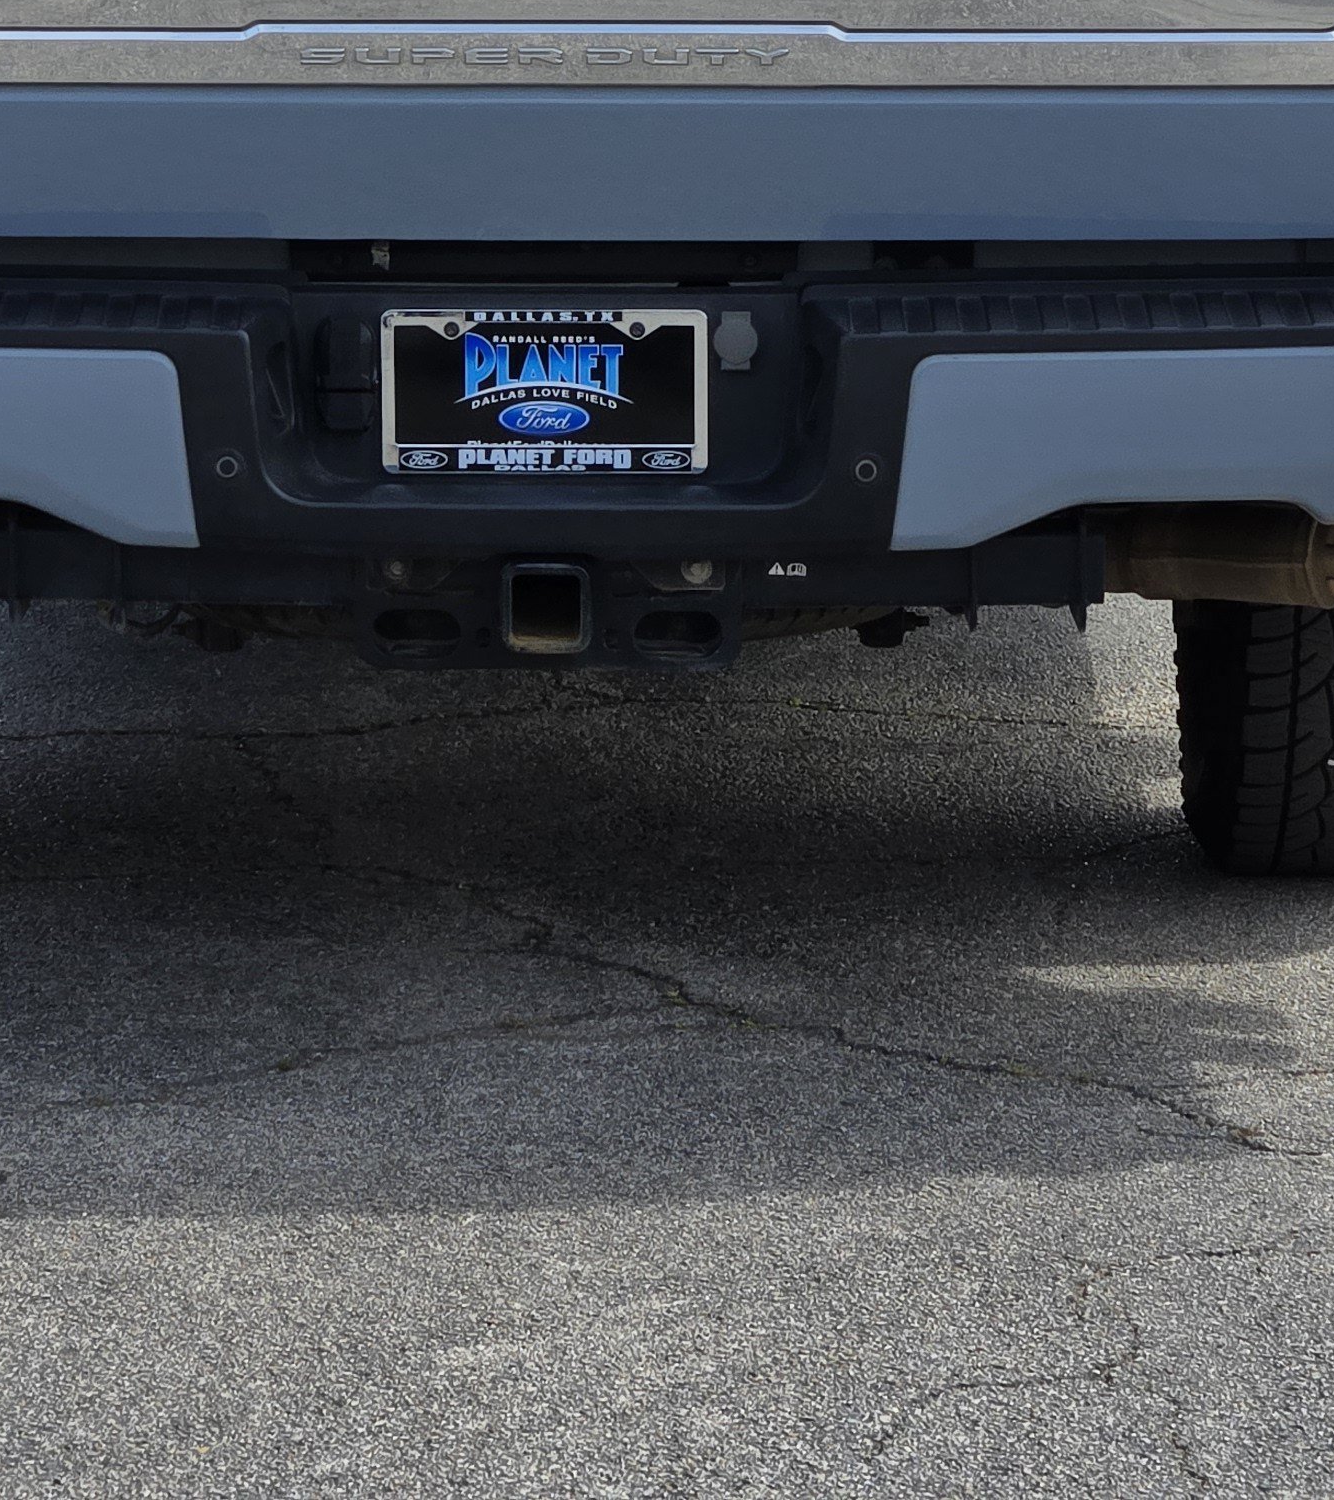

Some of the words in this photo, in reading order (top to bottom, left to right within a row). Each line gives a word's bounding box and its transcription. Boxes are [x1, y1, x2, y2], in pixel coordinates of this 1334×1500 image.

[300, 46, 564, 66] SUPER
[586, 46, 790, 66] DUTY
[584, 311, 614, 322] TX
[464, 332, 624, 399] PLANET
[471, 389, 526, 410] DALLAS
[533, 388, 570, 398] LOVE
[576, 391, 618, 410] FIELD
[516, 405, 572, 430] Ford
[408, 452, 440, 466] Ford
[458, 449, 555, 469] PLANET
[563, 449, 632, 469] FORD
[494, 464, 587, 472] DALLAS
[651, 452, 682, 466] Ford
